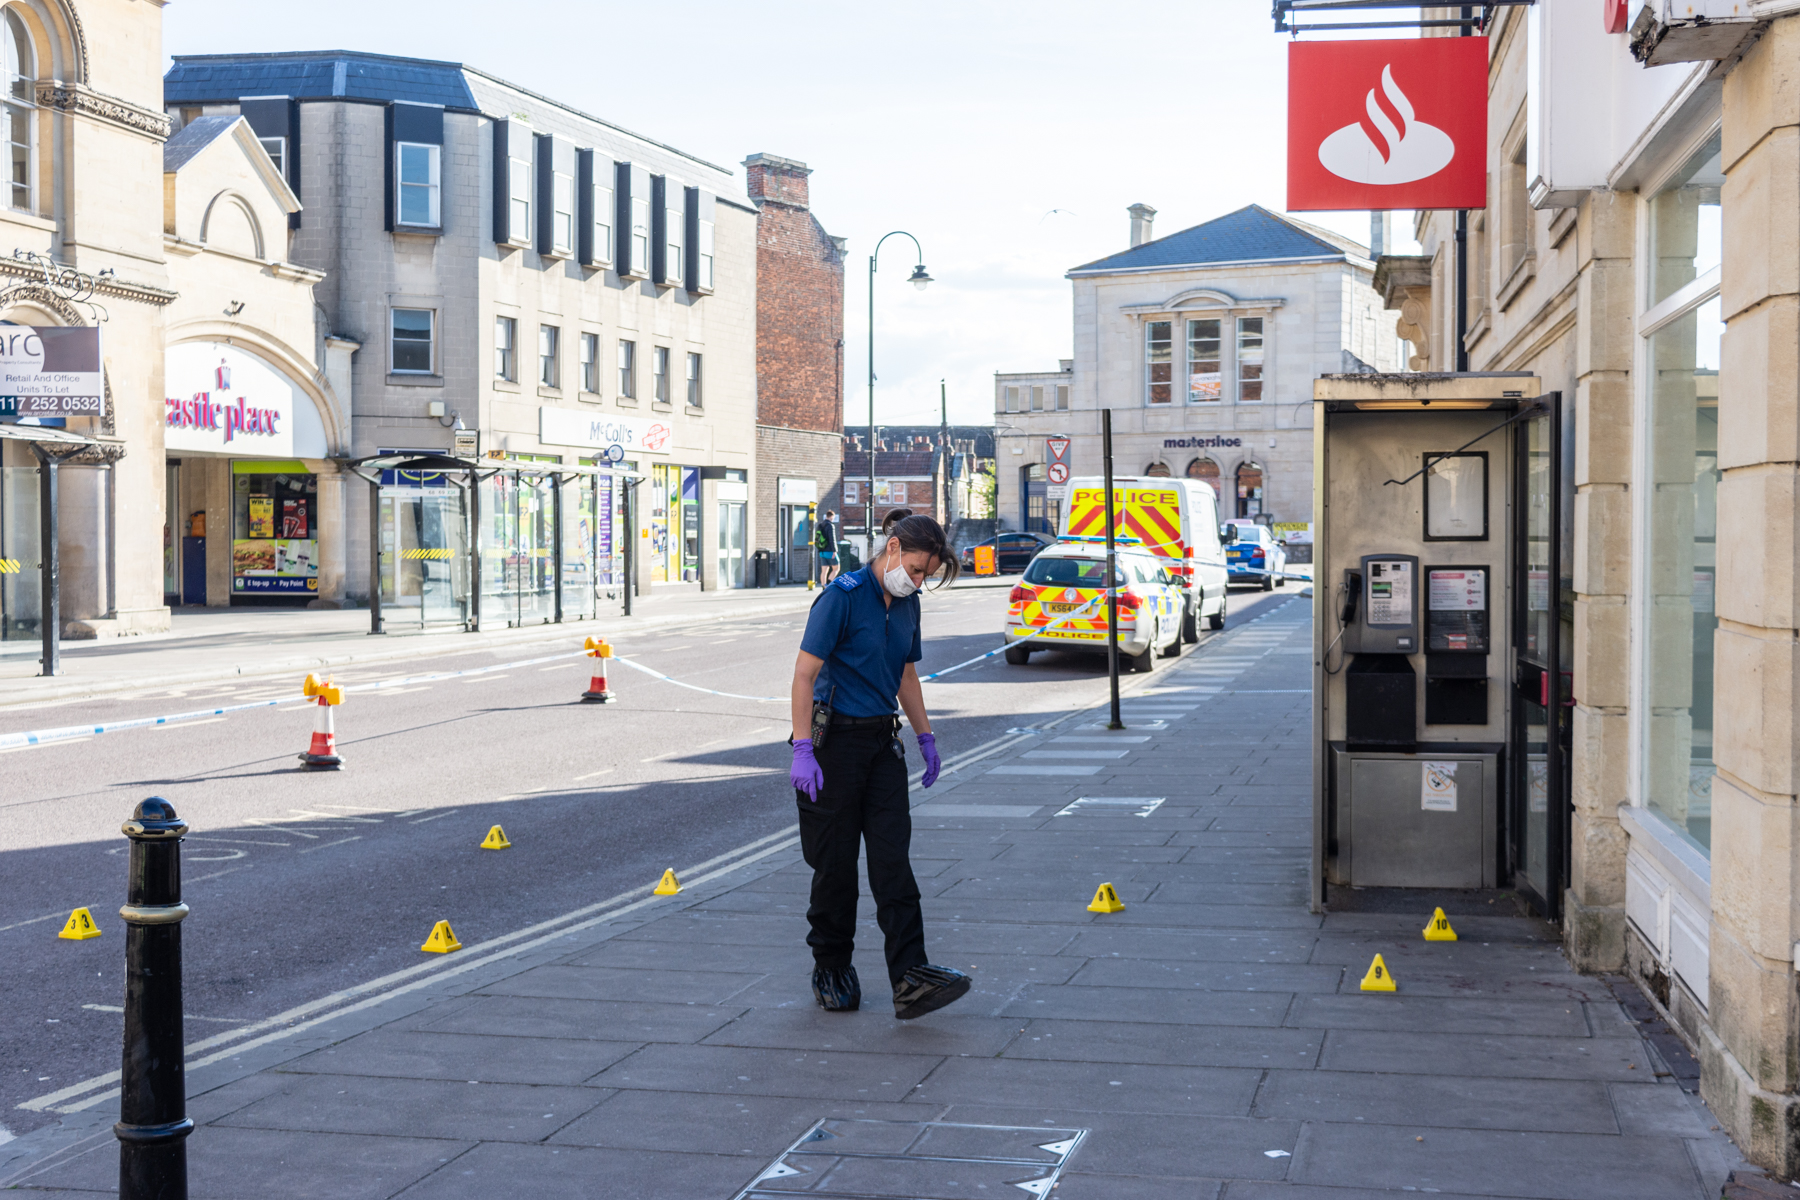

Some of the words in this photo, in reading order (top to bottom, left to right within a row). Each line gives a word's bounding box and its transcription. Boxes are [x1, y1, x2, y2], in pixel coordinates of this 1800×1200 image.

[5, 374, 31, 382] Retail
[33, 374, 52, 382] And
[54, 374, 80, 382] Office
[16, 386, 40, 394] Units
[43, 386, 53, 394] To
[55, 386, 69, 394] Let
[30, 397, 58, 410] 252
[62, 397, 99, 410] 0532
[224, 396, 281, 444] place
[590, 421, 632, 443] McColl's
[1164, 435, 1241, 448] mastershoe
[1075, 492, 1175, 504] POLICE
[1052, 604, 1071, 613] KS64
[490, 833, 494, 842] 6
[664, 877, 669, 885] 5
[1107, 886, 1115, 901] 8
[71, 919, 76, 930] 3
[81, 913, 90, 928] 3
[1436, 918, 1447, 930] 10
[434, 932, 439, 941] 4
[446, 926, 453, 941] 4
[1375, 965, 1382, 979] 9
